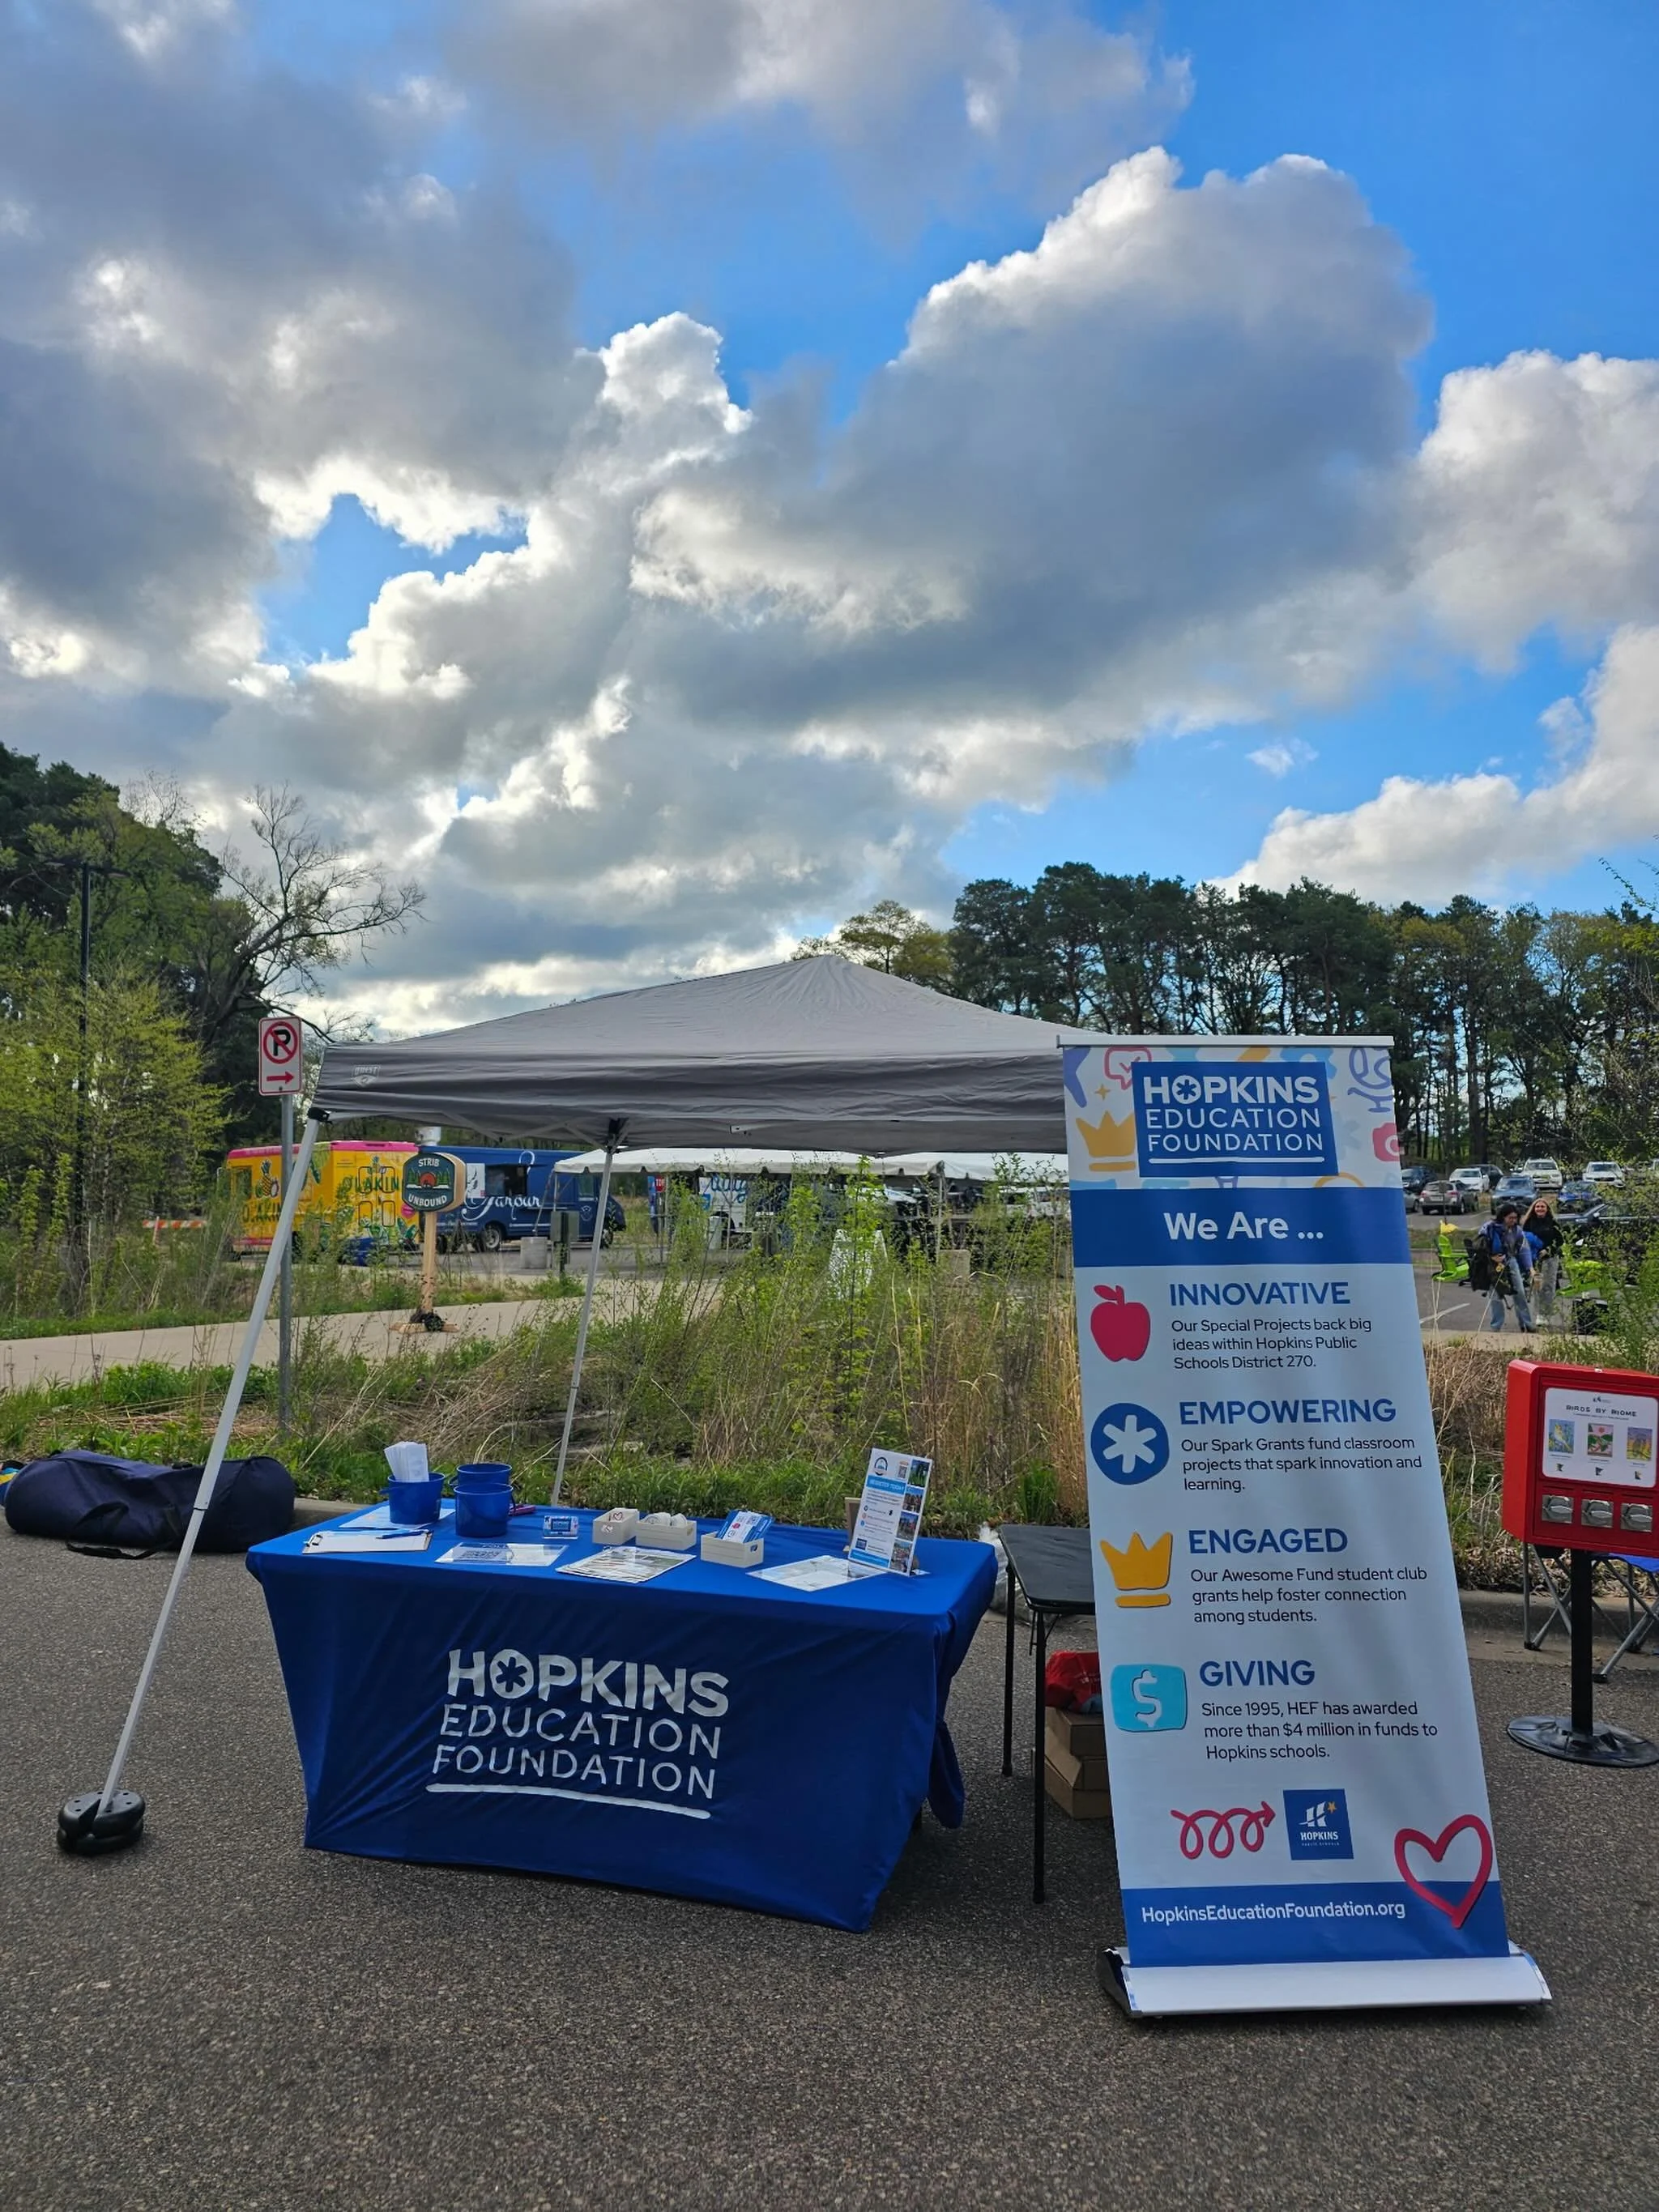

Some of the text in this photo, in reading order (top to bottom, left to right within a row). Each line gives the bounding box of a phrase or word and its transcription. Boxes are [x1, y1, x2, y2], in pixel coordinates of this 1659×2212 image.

[1144, 1075, 1319, 1105] HOPKINS
[1146, 1108, 1320, 1128] EDUCATION
[1149, 1133, 1323, 1152] FOUNDATION
[418, 1157, 440, 1167] STRIB
[408, 1193, 447, 1207] UNBOUND
[1164, 1212, 1218, 1240] We
[1227, 1212, 1288, 1238] Are
[1170, 1282, 1350, 1306] INNOVATIVE
[1171, 1317, 1371, 1334] Our Special Projects back big
[1173, 1336, 1357, 1353] ideas within Hopkins Public
[1174, 1356, 1316, 1369] Schools District 270.
[1179, 1399, 1396, 1425] EMPOWERING
[1181, 1438, 1414, 1455] Our Spark Grants fund classroom
[1183, 1456, 1422, 1474] projects that spark innovation and
[1184, 1477, 1245, 1494] learning.
[1189, 1528, 1348, 1554] ENGAGED
[1191, 1566, 1427, 1582] Our Awesome Fund student club
[1193, 1588, 1406, 1605] grants help foster connection
[1194, 1609, 1316, 1625] among students.
[1199, 1660, 1315, 1686] GIVING
[447, 1648, 729, 1717] HOPKINS
[1202, 1702, 1418, 1717] Since 1995, HEF has awarded
[441, 1703, 721, 1759] EDUCATION
[1205, 1723, 1437, 1737] more than $4 million in funds to
[1206, 1745, 1329, 1762] Hopkins schools.
[433, 1745, 715, 1799] FOUNDATION
[1300, 1831, 1338, 1841] HOPKINS
[1142, 1902, 1405, 1925] HopkinsEducationFoundation.org
